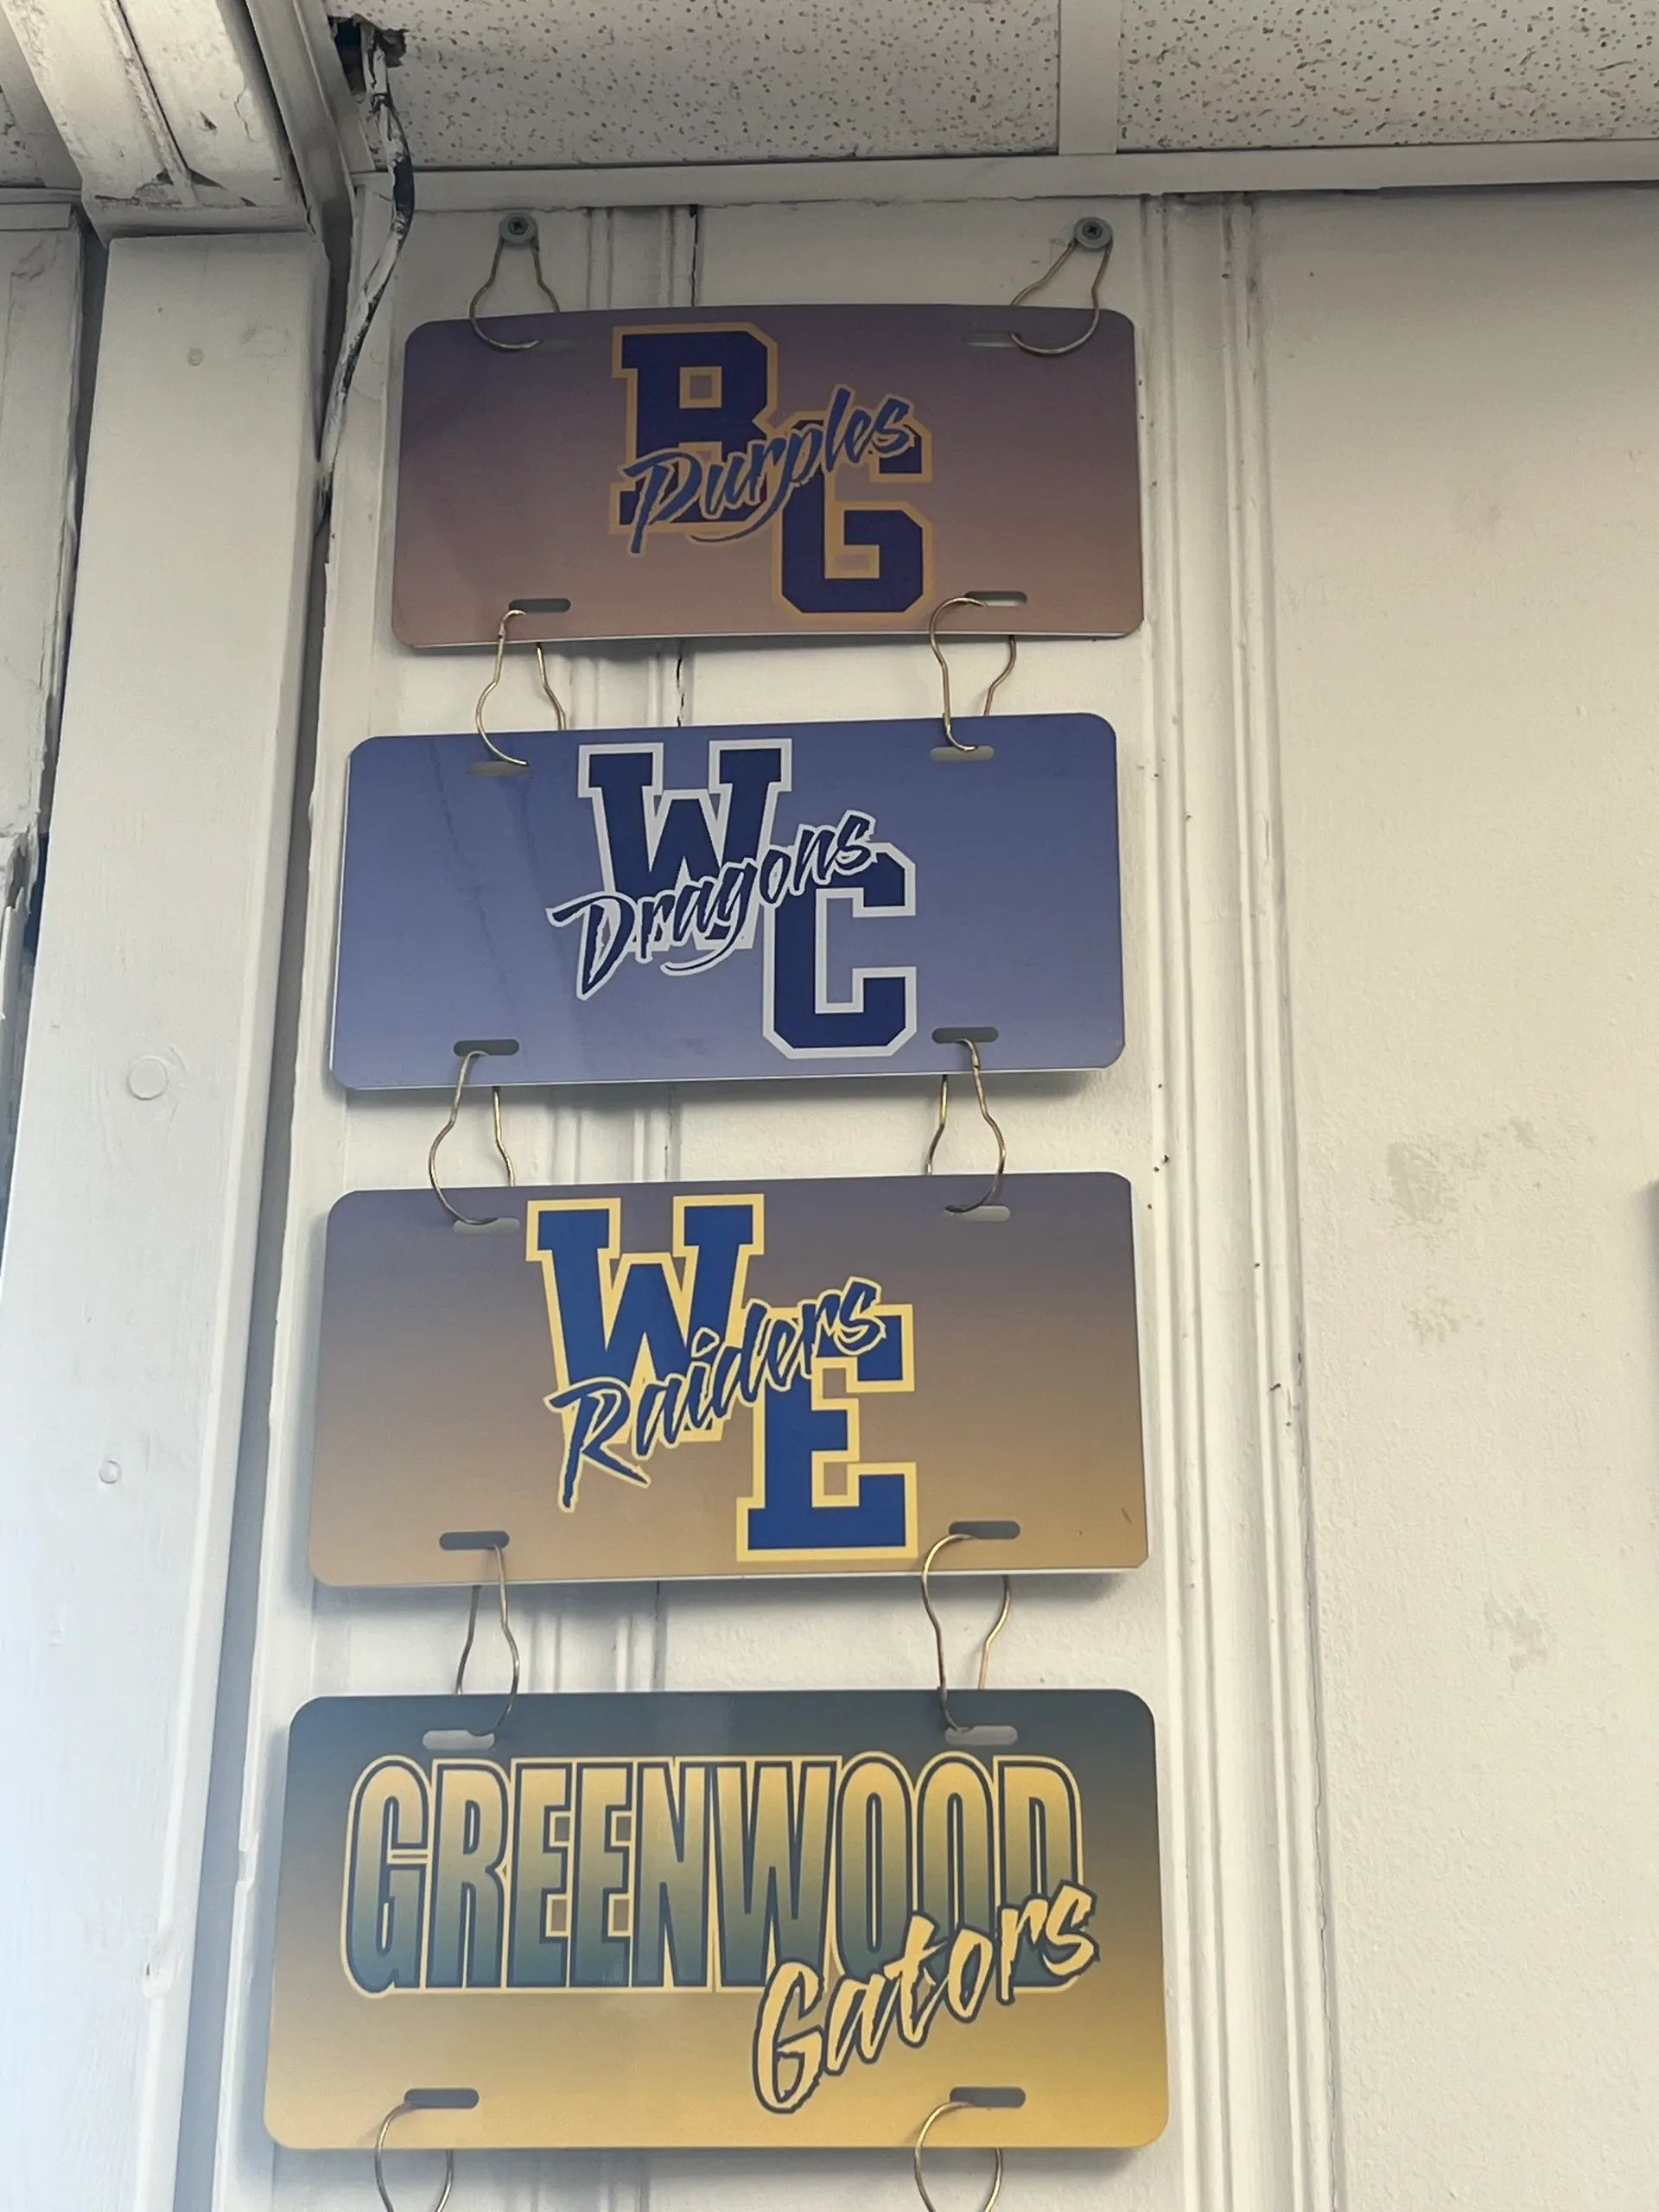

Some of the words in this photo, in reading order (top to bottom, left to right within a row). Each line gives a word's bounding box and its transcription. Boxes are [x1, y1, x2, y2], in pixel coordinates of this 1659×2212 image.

[620, 385, 916, 556] Purples
[546, 810, 878, 1000] Dragons
[543, 1276, 888, 1512] Raiders
[341, 1751, 1084, 1998] GREENWOOD
[752, 1879, 1101, 2113] Gators
